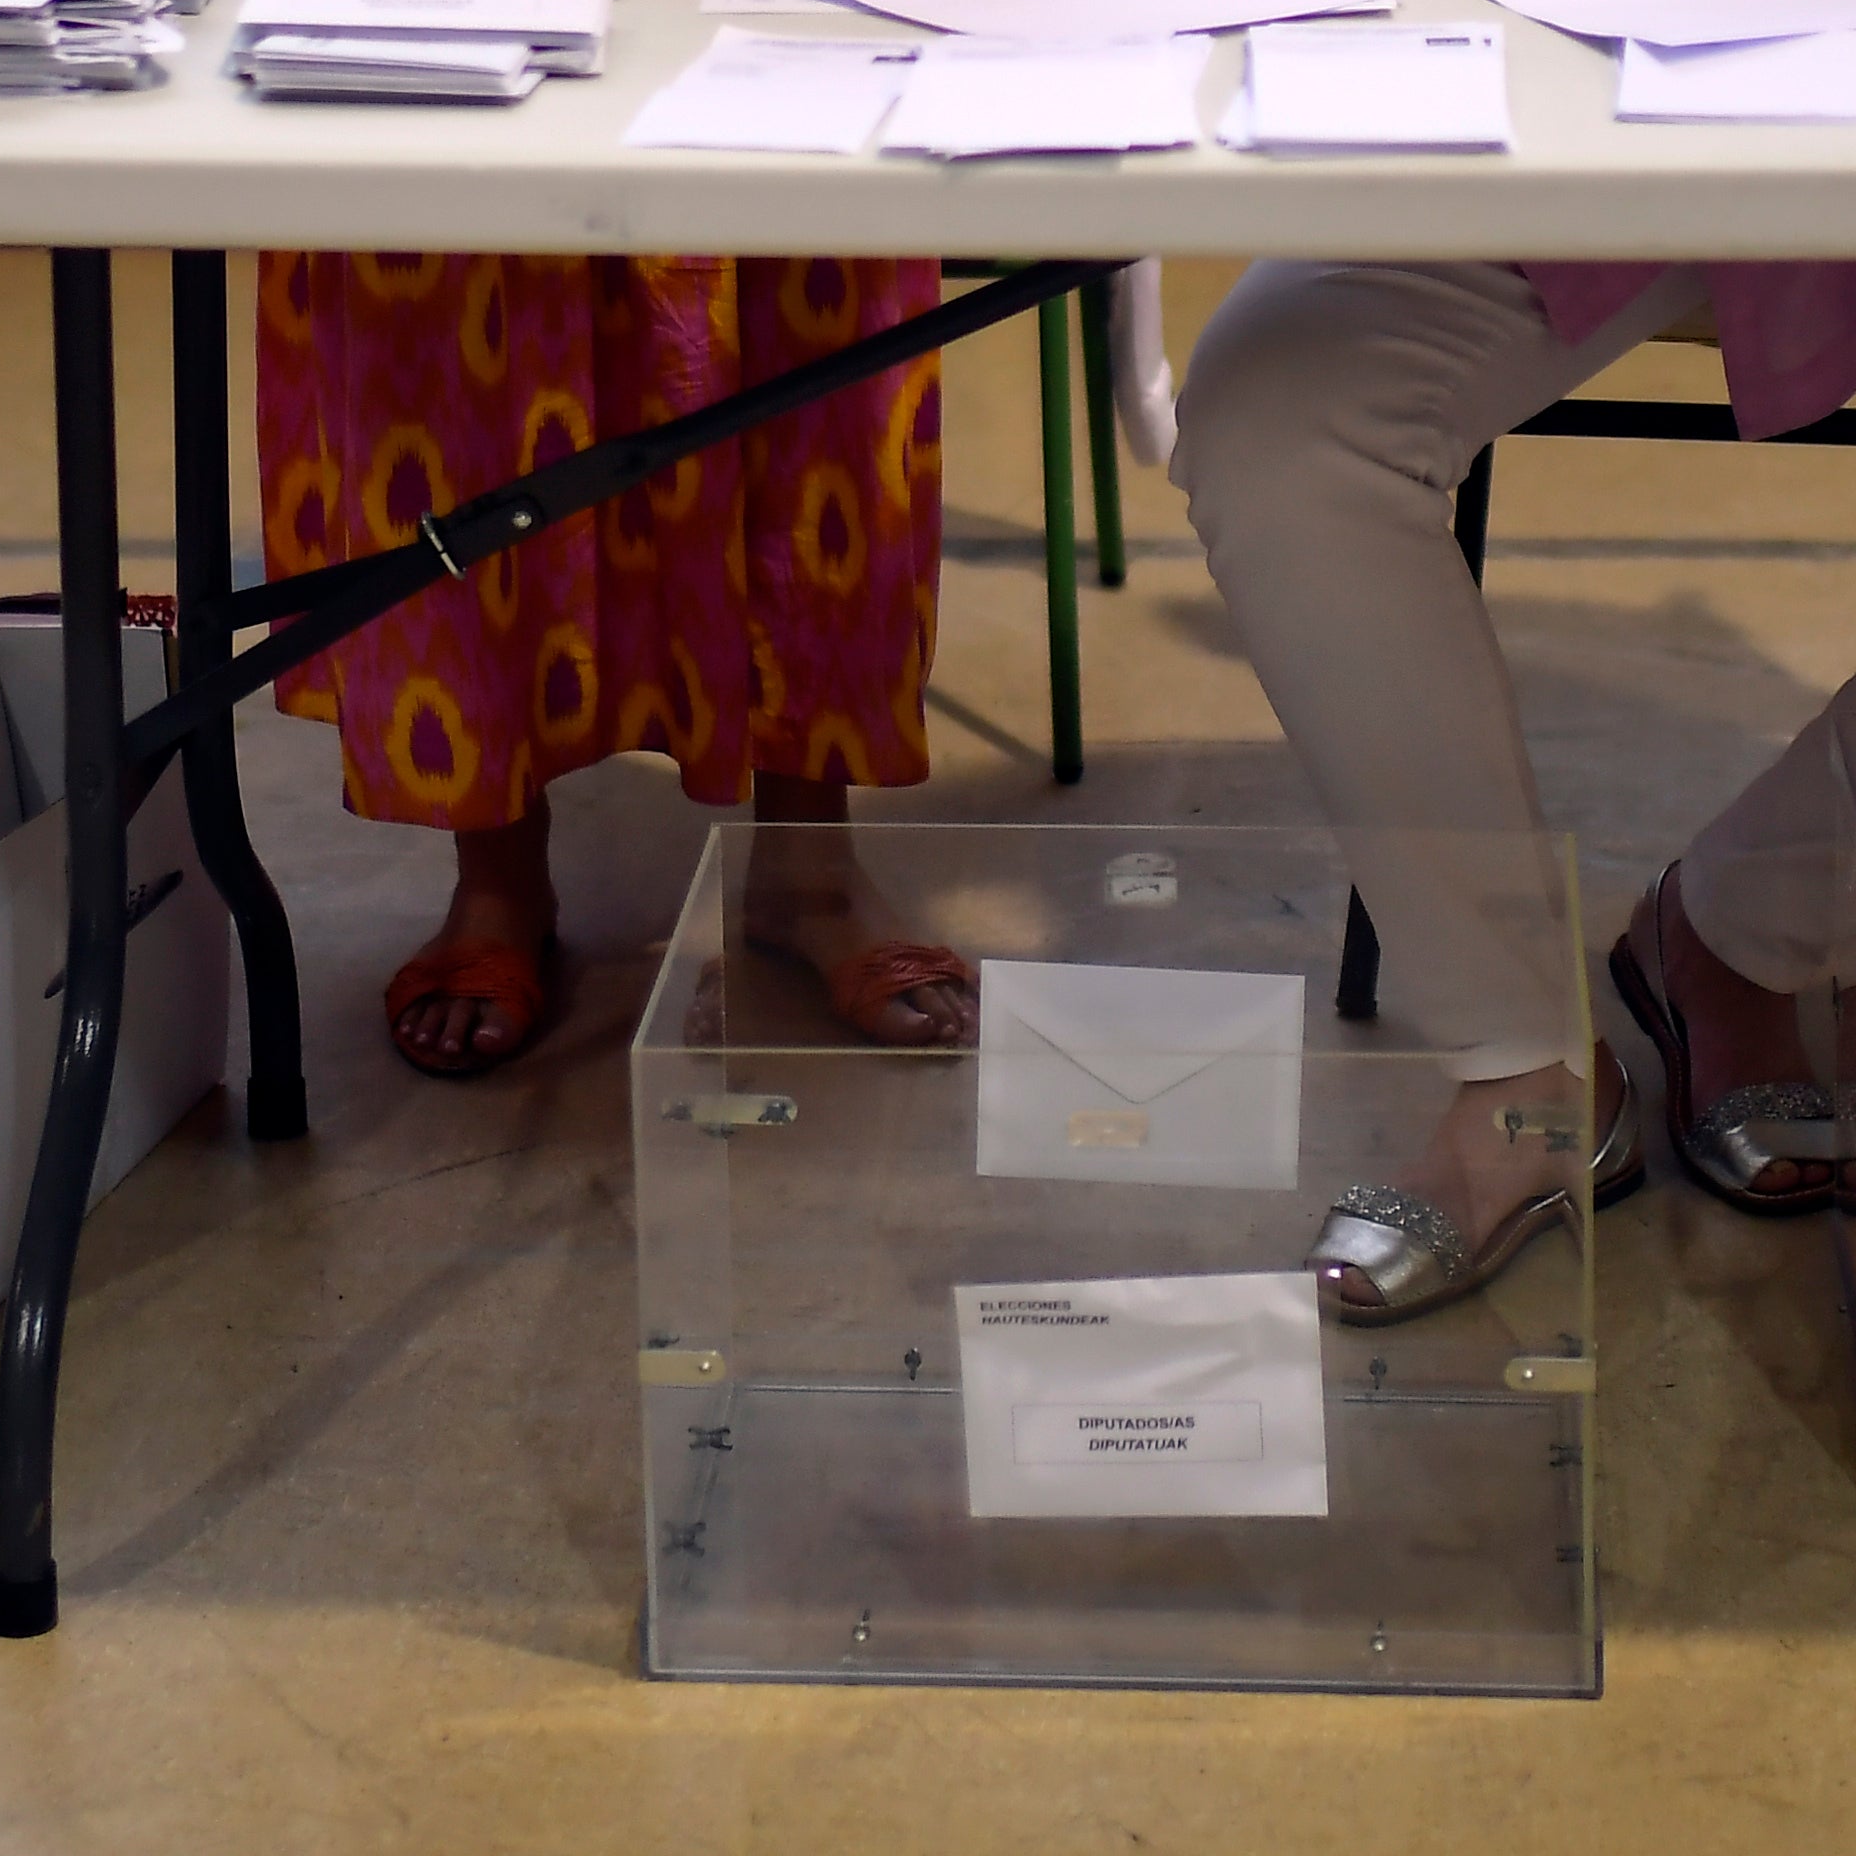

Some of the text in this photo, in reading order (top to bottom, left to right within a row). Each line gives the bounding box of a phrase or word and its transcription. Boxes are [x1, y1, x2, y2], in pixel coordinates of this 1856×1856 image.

[980, 1300, 1072, 1312] ELECCIONES
[981, 1315, 1111, 1326] HAUTESKUNDEAK
[1078, 1416, 1196, 1431] DIPUTADOS/AS
[1088, 1437, 1188, 1452] DIPUTATUAK
